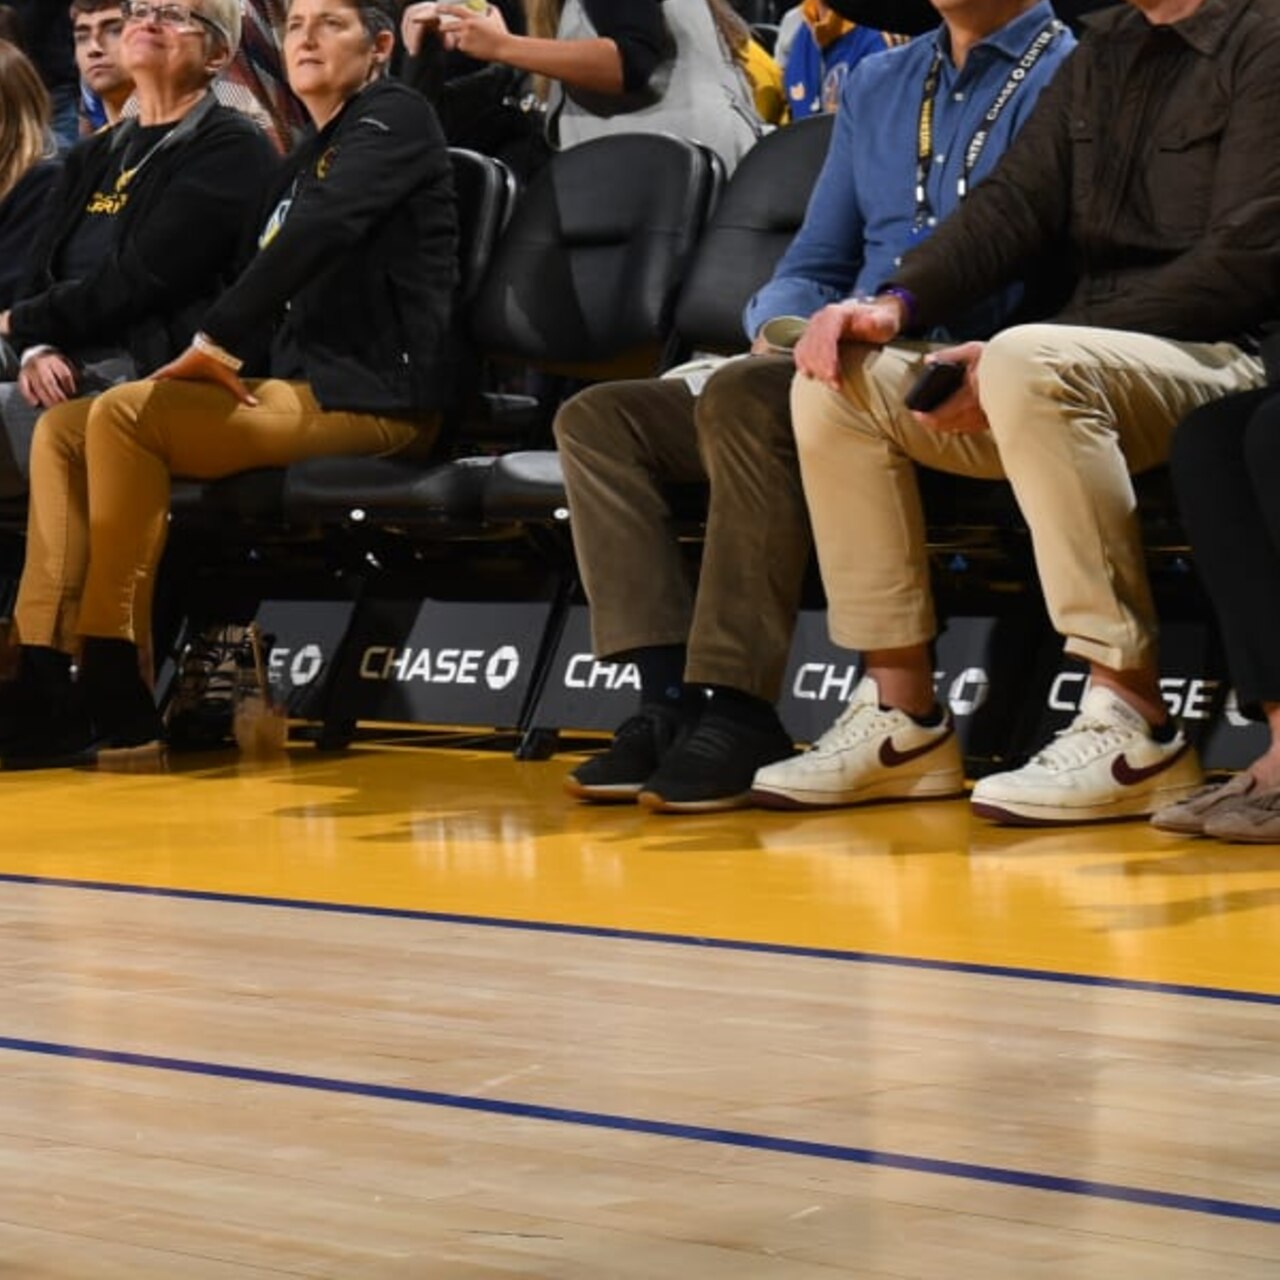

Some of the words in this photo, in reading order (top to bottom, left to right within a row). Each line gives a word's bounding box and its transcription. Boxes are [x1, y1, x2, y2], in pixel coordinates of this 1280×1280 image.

[986, 78, 1017, 120] CHASE
[1020, 31, 1054, 68] CENTER
[359, 644, 485, 684] CHASE
[563, 653, 642, 692] CHA
[1047, 670, 1220, 720] CSE
